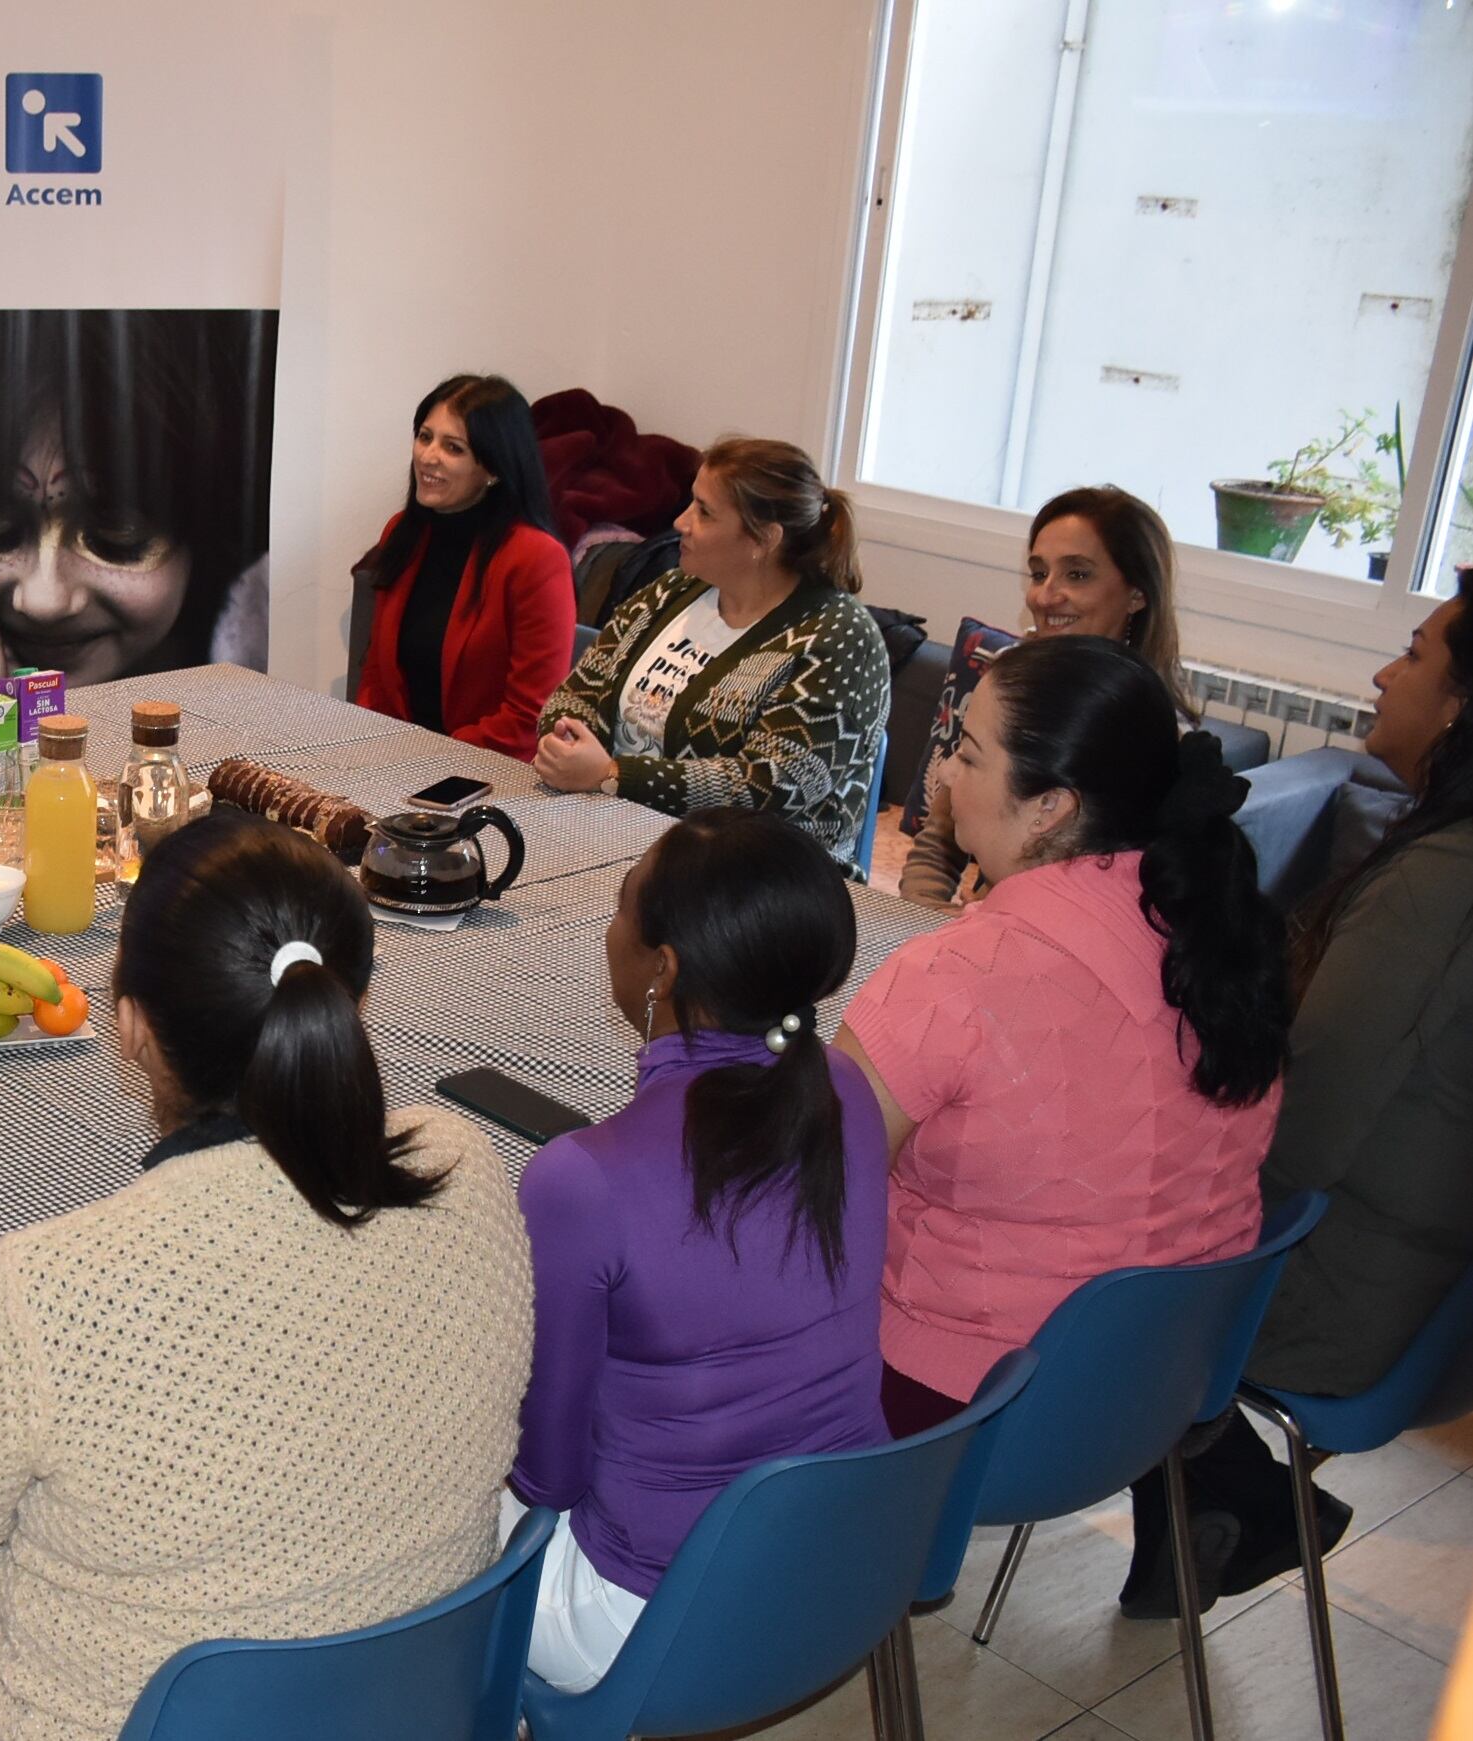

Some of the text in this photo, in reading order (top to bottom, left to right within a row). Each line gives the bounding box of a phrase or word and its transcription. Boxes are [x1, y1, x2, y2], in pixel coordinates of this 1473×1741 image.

[5, 183, 102, 205] Accem
[28, 677, 59, 691] Pascual
[36, 698, 50, 708] SIN
[28, 704, 58, 716] LACTOSA
